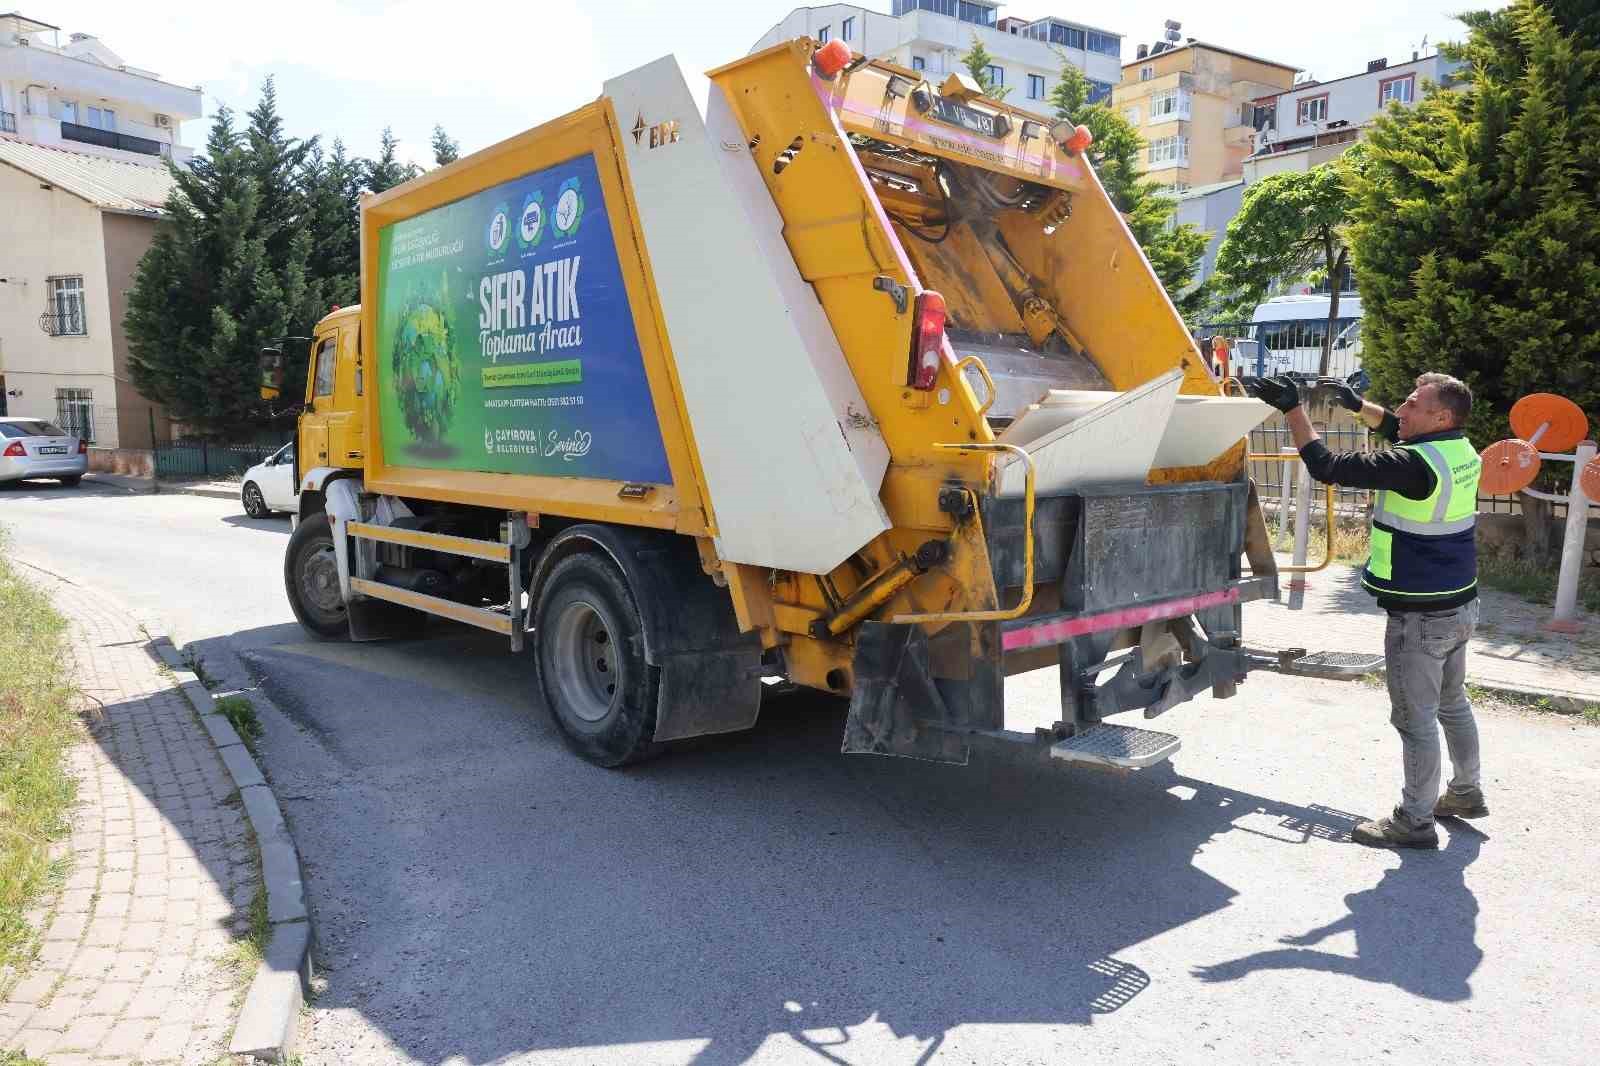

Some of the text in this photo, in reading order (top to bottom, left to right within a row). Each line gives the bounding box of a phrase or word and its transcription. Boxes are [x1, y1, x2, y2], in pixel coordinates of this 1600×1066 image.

[479, 255, 580, 331] SIFIR ATIK
[479, 321, 583, 363] Toplama Aracı
